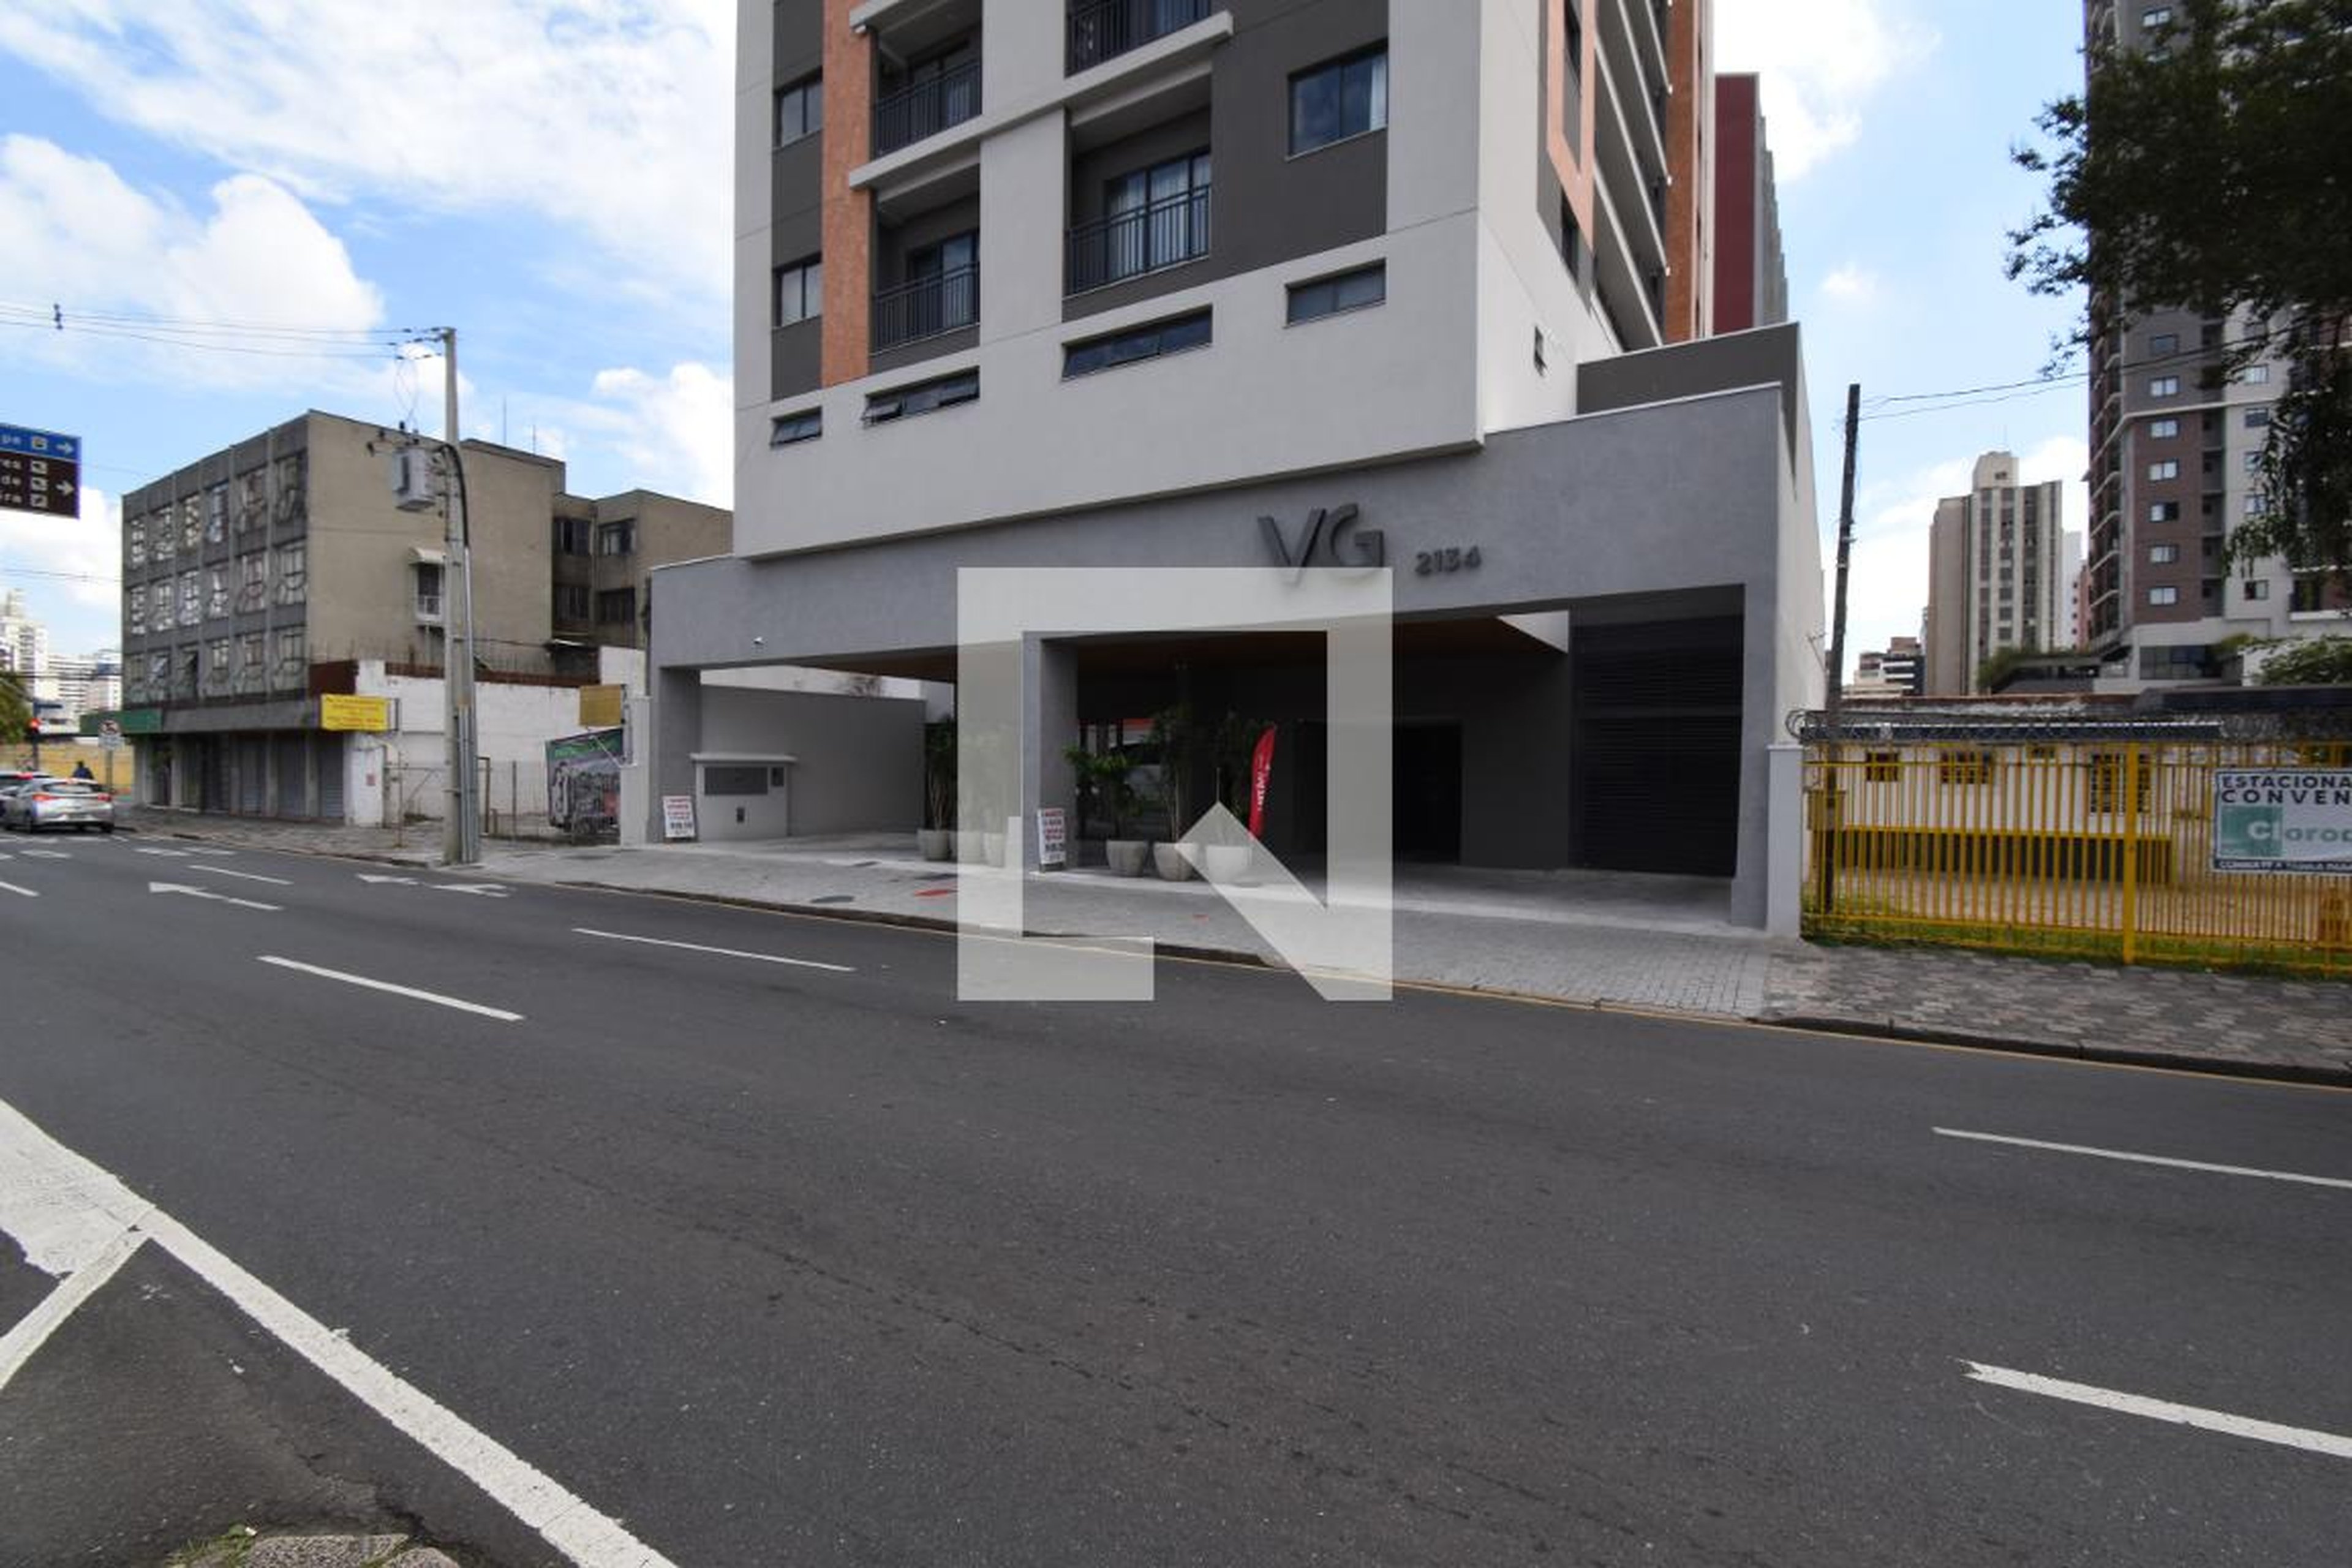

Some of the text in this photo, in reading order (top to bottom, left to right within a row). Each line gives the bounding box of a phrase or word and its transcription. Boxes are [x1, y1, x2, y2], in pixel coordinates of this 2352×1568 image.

[1257, 503, 1482, 588] VG 2134
[2222, 776, 2352, 788] ESTACIONA
[2222, 790, 2350, 804] CONVEN
